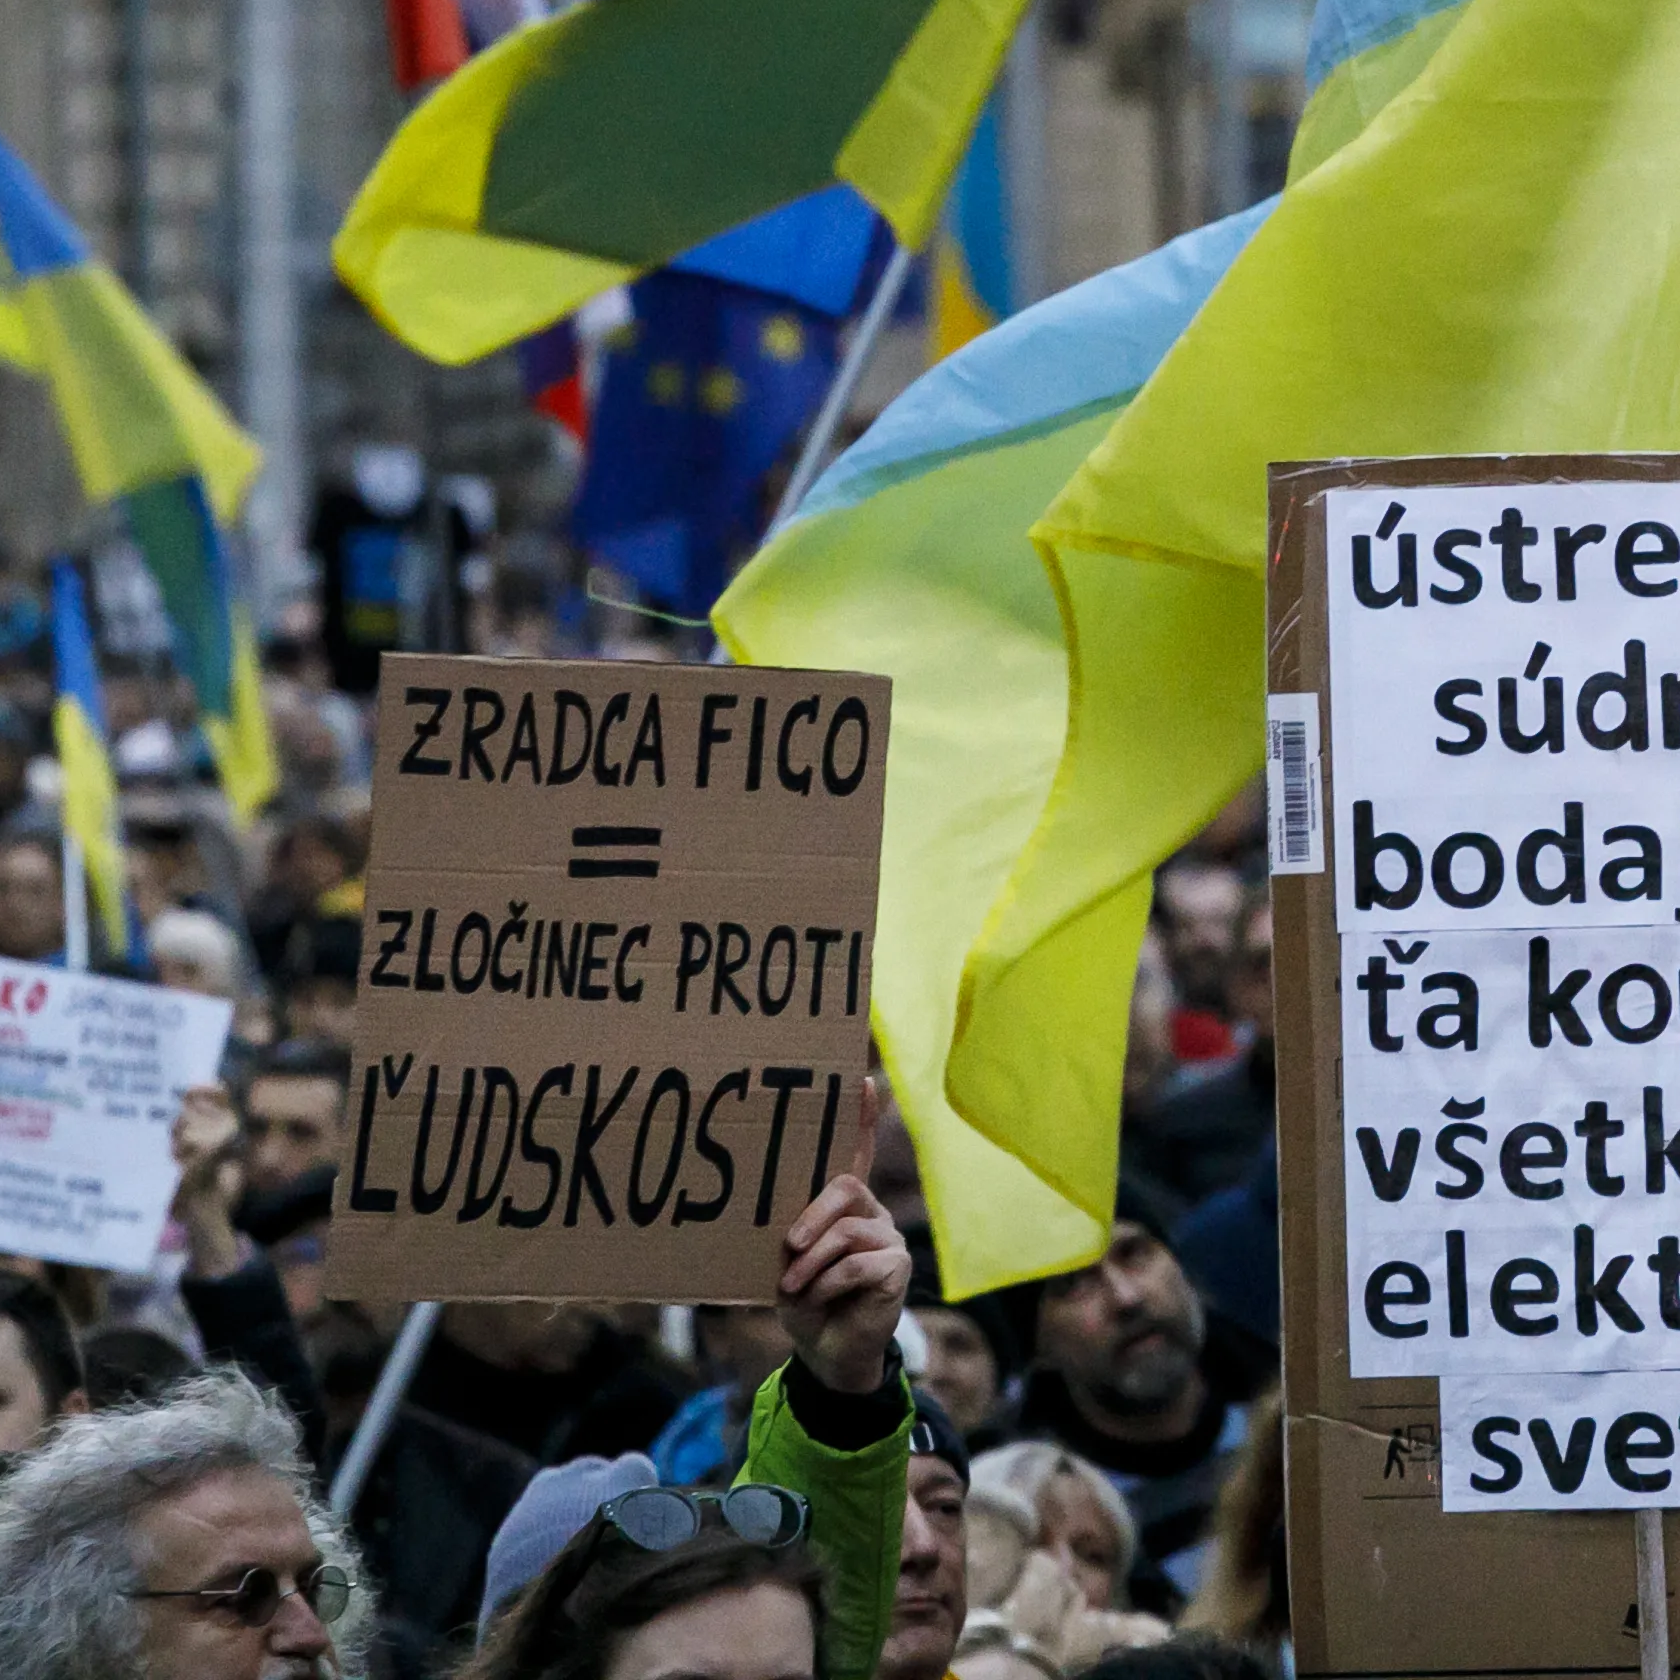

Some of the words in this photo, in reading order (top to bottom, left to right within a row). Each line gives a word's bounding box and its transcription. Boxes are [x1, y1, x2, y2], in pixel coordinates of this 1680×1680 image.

[399, 686, 668, 788] ZRADCA
[695, 693, 871, 799] FICO
[369, 900, 654, 1005] ZLOČINEC
[673, 921, 865, 1018] PROTI
[1356, 937, 1481, 1055] ťa
